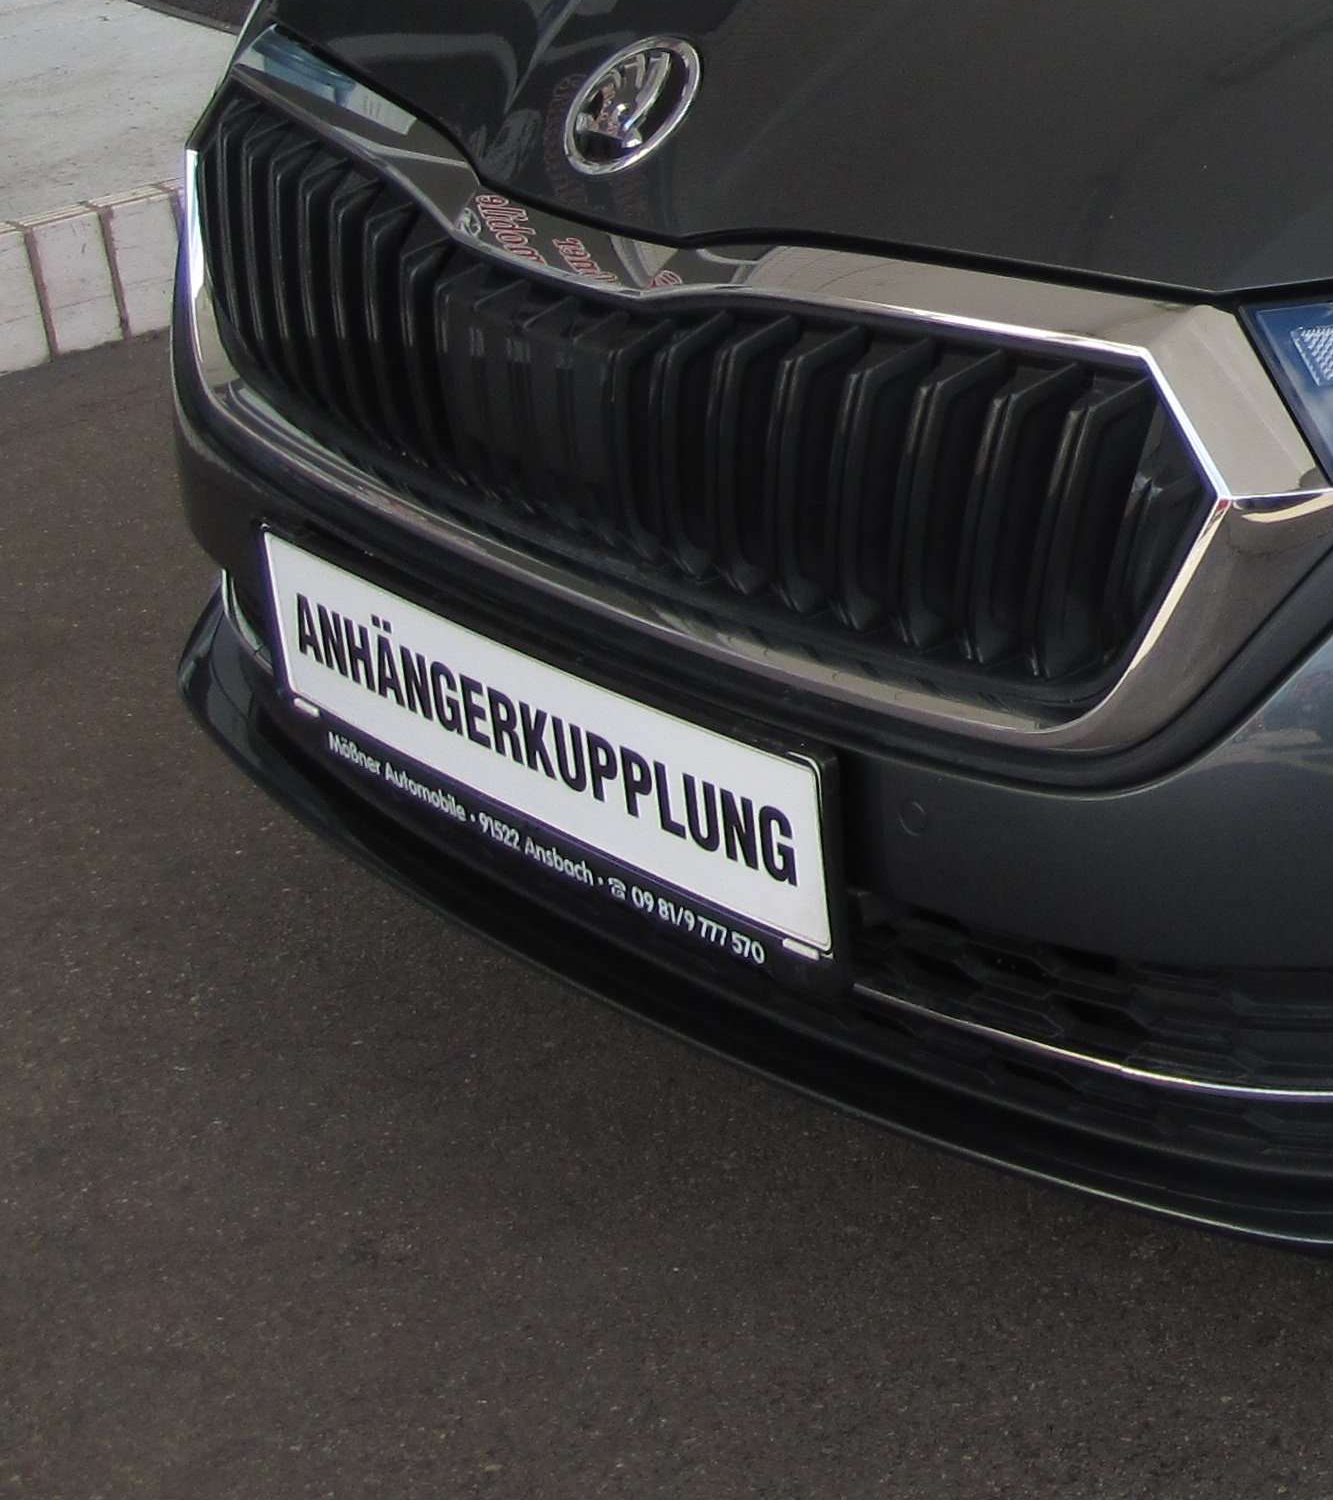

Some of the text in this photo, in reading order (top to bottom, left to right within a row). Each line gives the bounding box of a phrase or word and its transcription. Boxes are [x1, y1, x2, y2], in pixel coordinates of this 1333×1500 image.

[295, 592, 798, 887] ANHÄNGERKUPPLUNG
[327, 731, 766, 965] Mößner Automobile 91522 Ansbach 09 81/9 777 570
